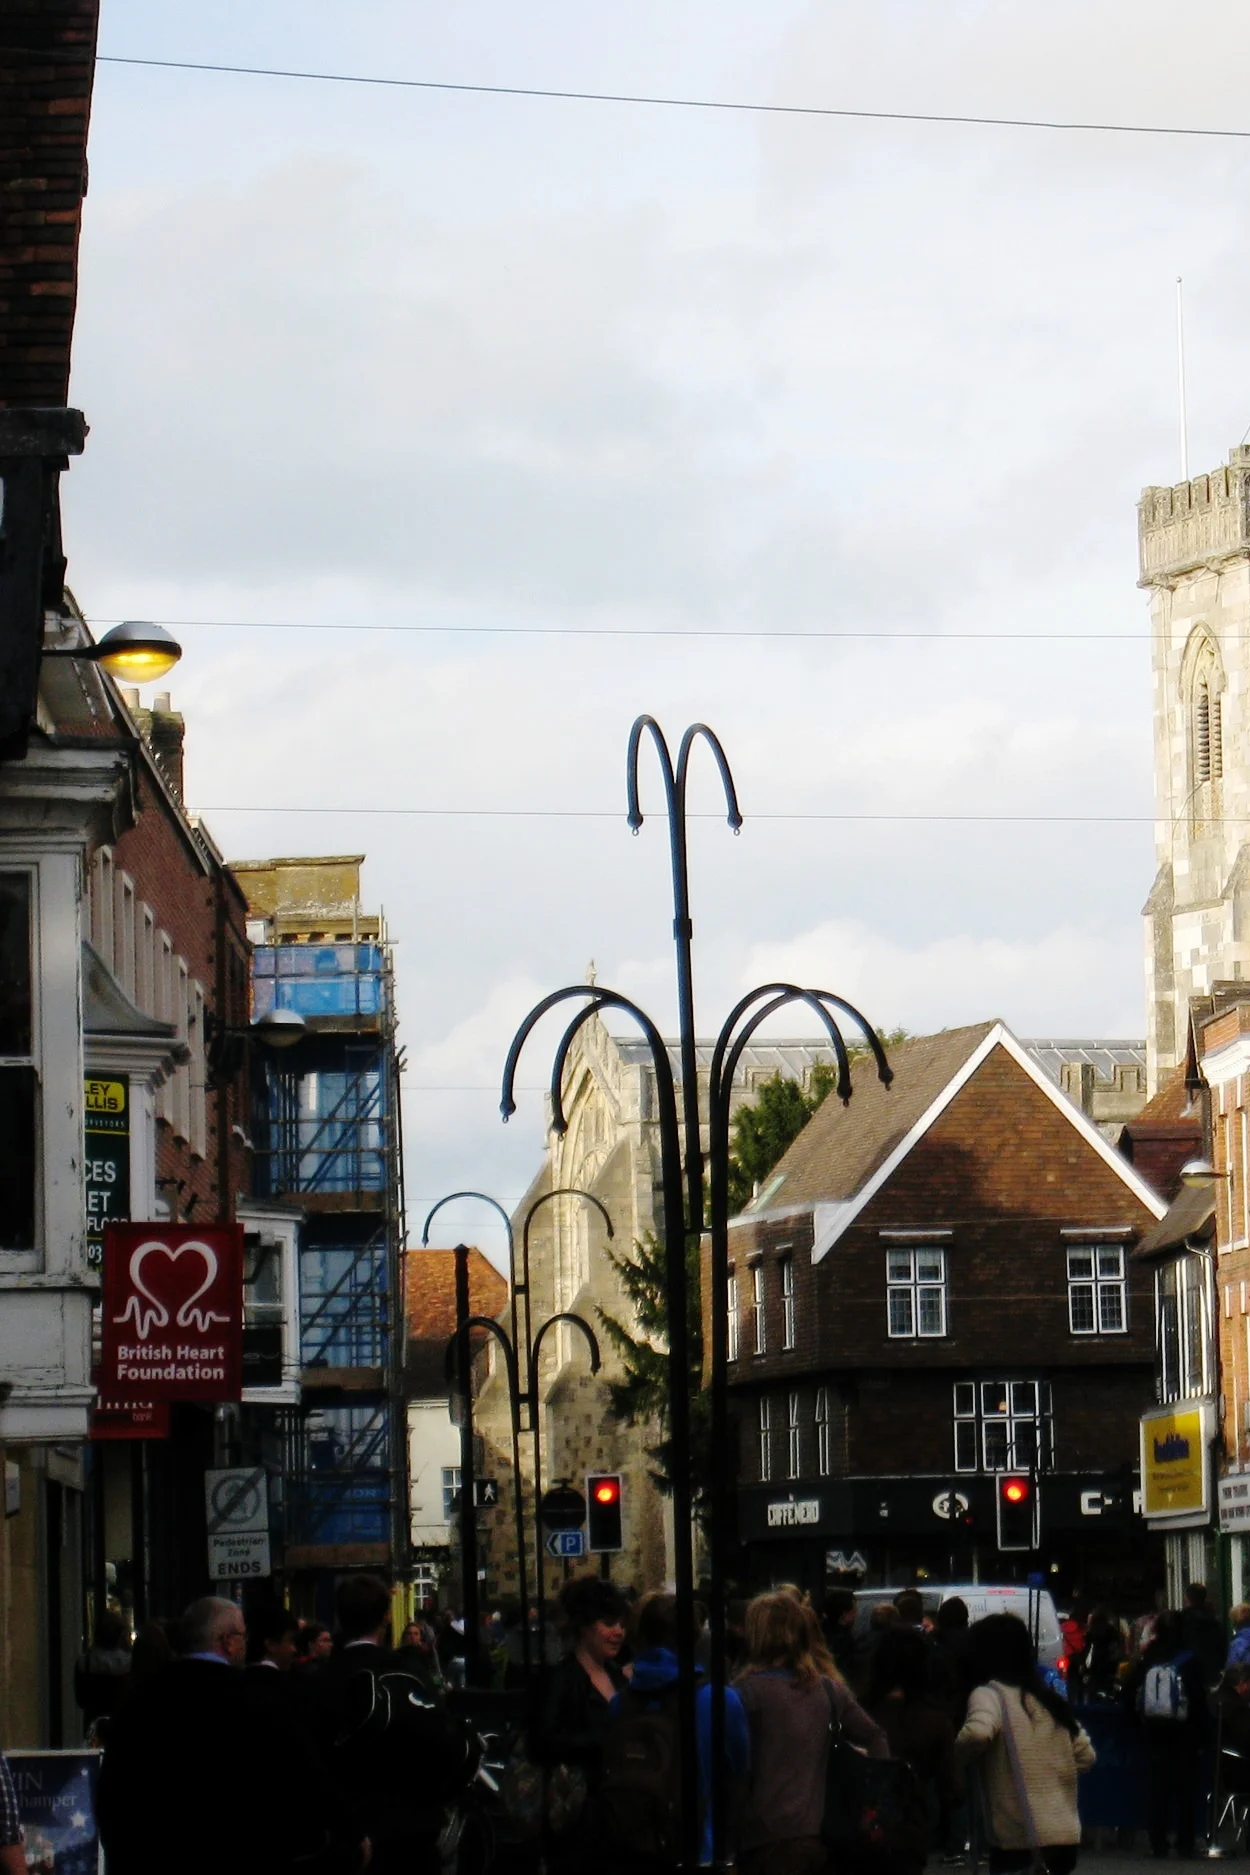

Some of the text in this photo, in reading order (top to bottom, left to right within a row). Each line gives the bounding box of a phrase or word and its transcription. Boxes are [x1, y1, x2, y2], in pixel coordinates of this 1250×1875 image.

[117, 1345, 225, 1360] British Heart
[117, 1364, 225, 1380] Foundation
[213, 1536, 264, 1547] Pedestrian
[566, 1536, 576, 1550] P
[218, 1561, 261, 1575] ENDS
